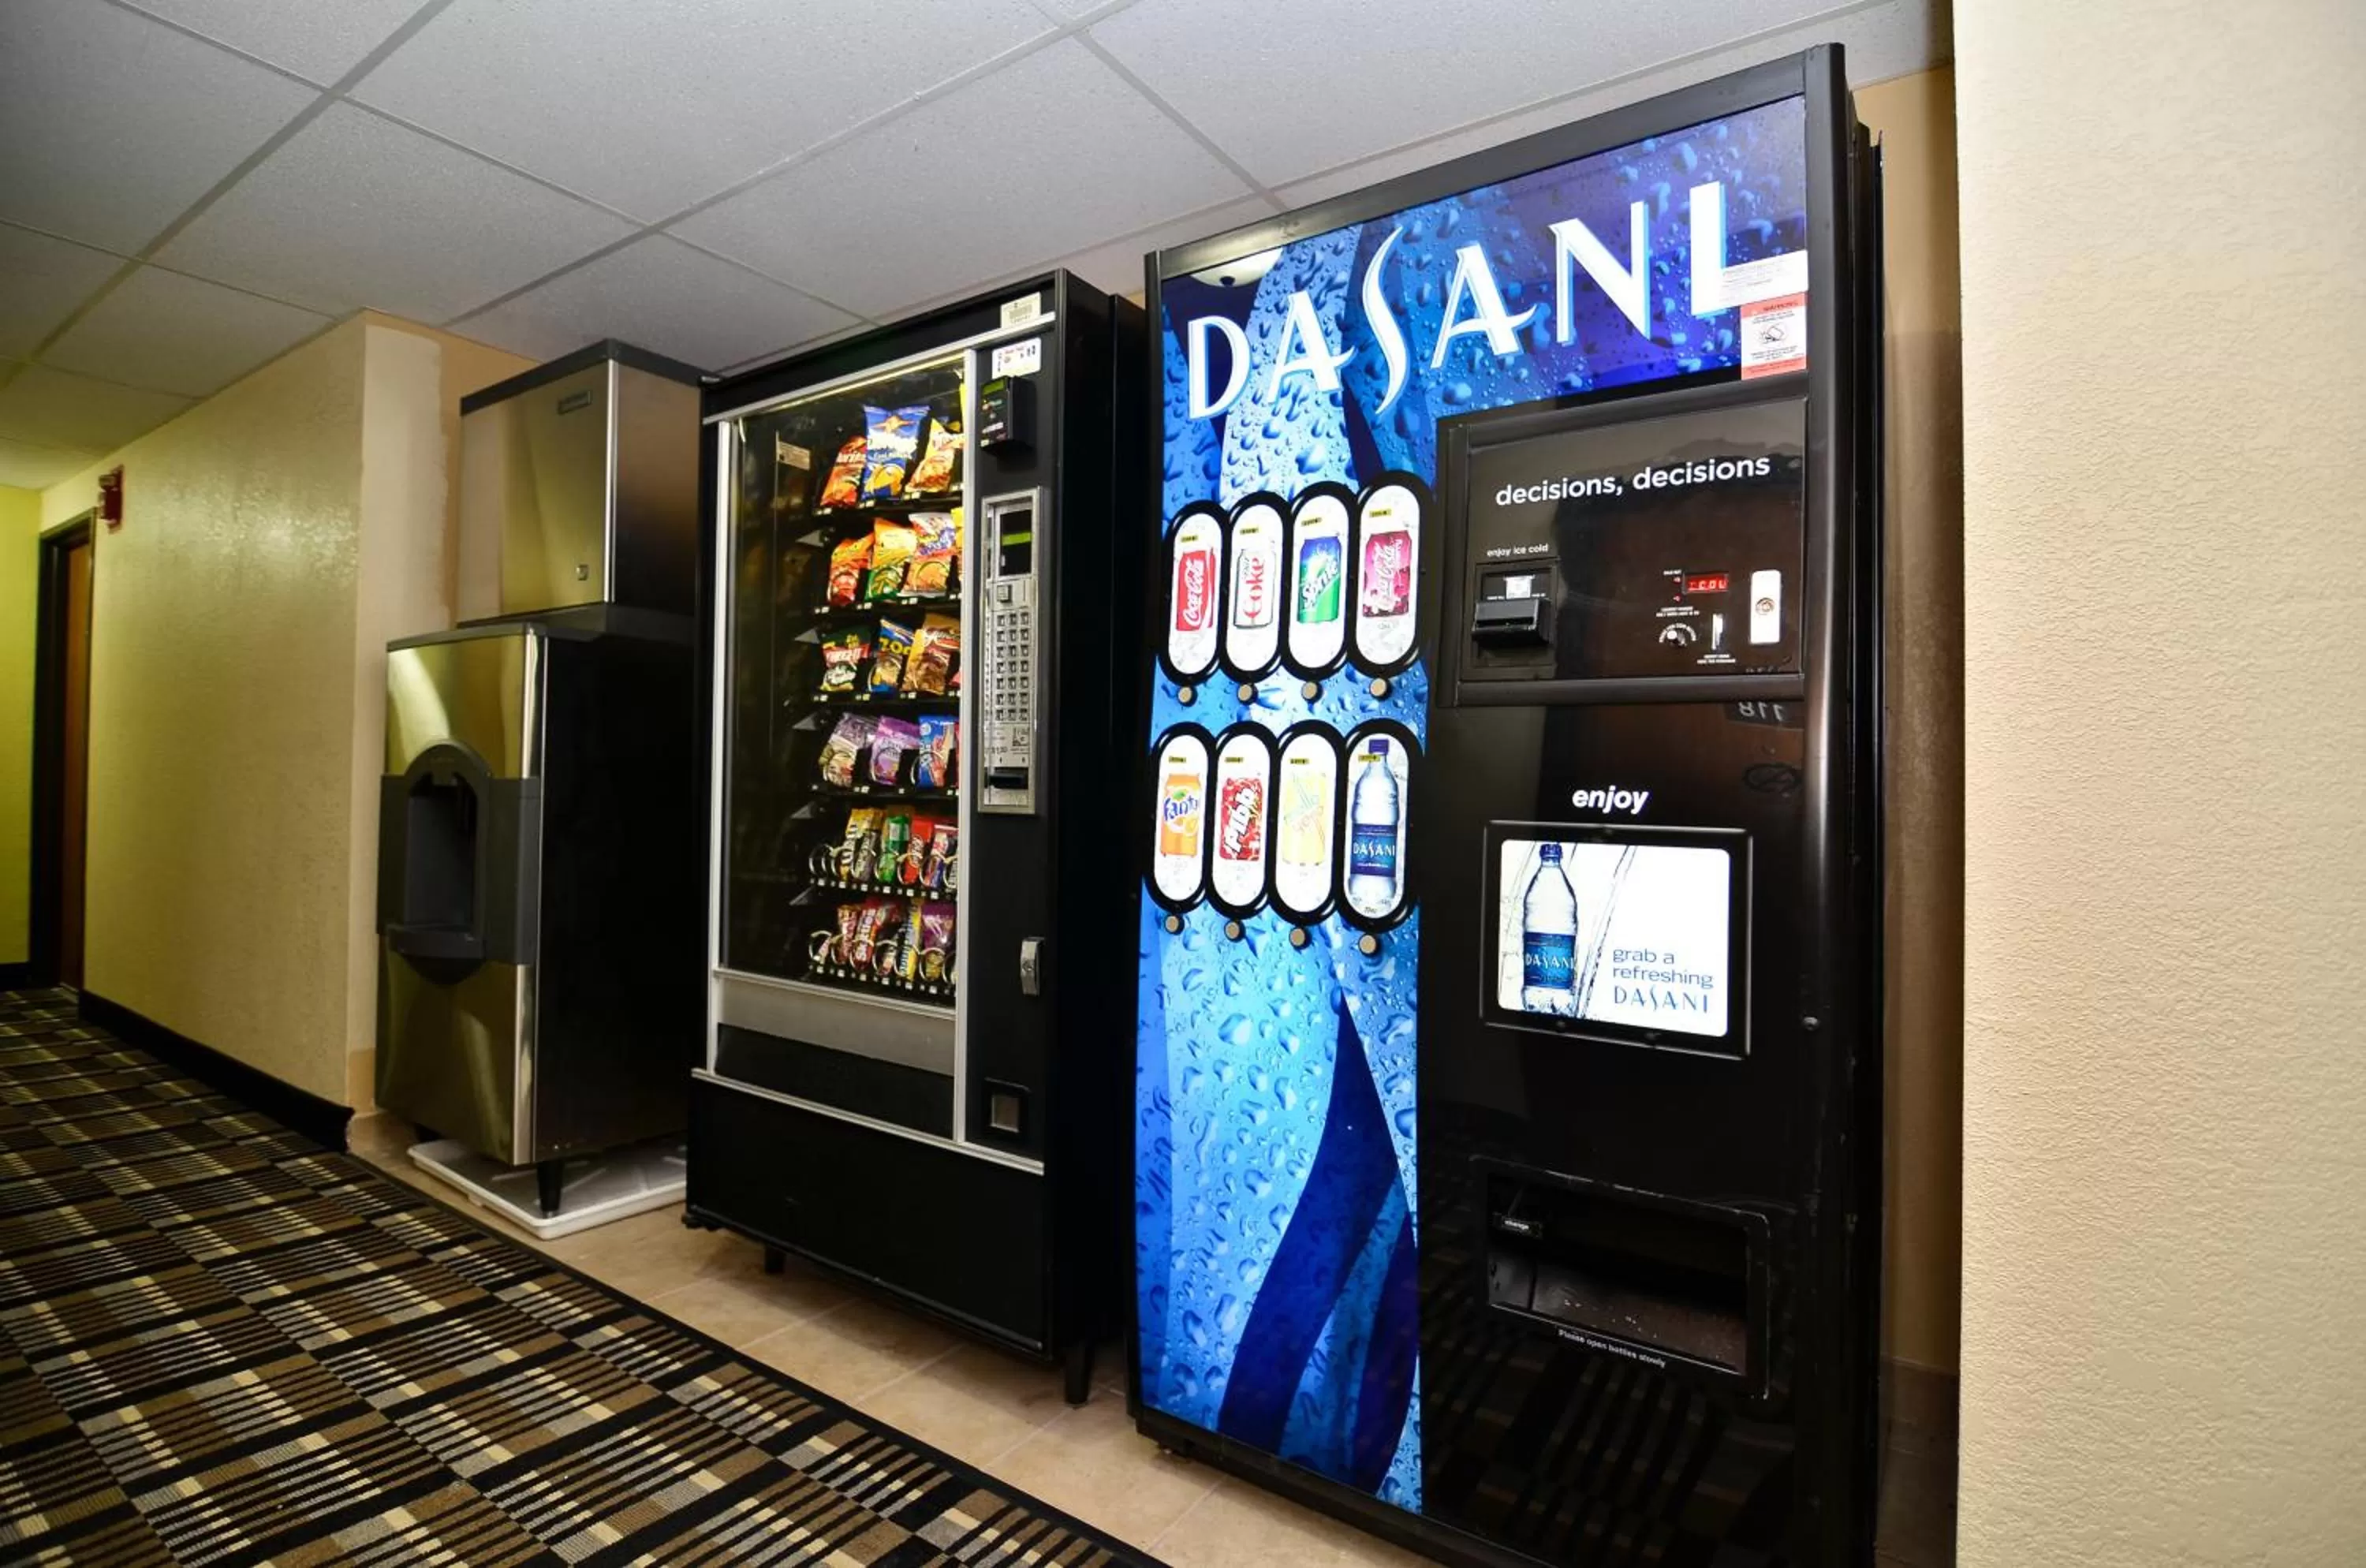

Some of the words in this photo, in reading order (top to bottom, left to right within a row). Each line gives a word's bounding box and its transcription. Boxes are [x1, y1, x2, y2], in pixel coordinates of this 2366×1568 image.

[1188, 181, 1727, 420] DASANI
[1496, 476, 1623, 506] decisions,
[1633, 457, 1771, 491] decisions
[1528, 543, 1548, 553] cold
[1572, 786, 1648, 814] enjoy
[1353, 841, 1395, 857] DASANI
[1526, 949, 1574, 969] DASANI
[1613, 948, 1657, 963] grab
[1663, 953, 1674, 964] a
[1613, 966, 1714, 989] refreshing
[1614, 985, 1708, 1013] DASANI
